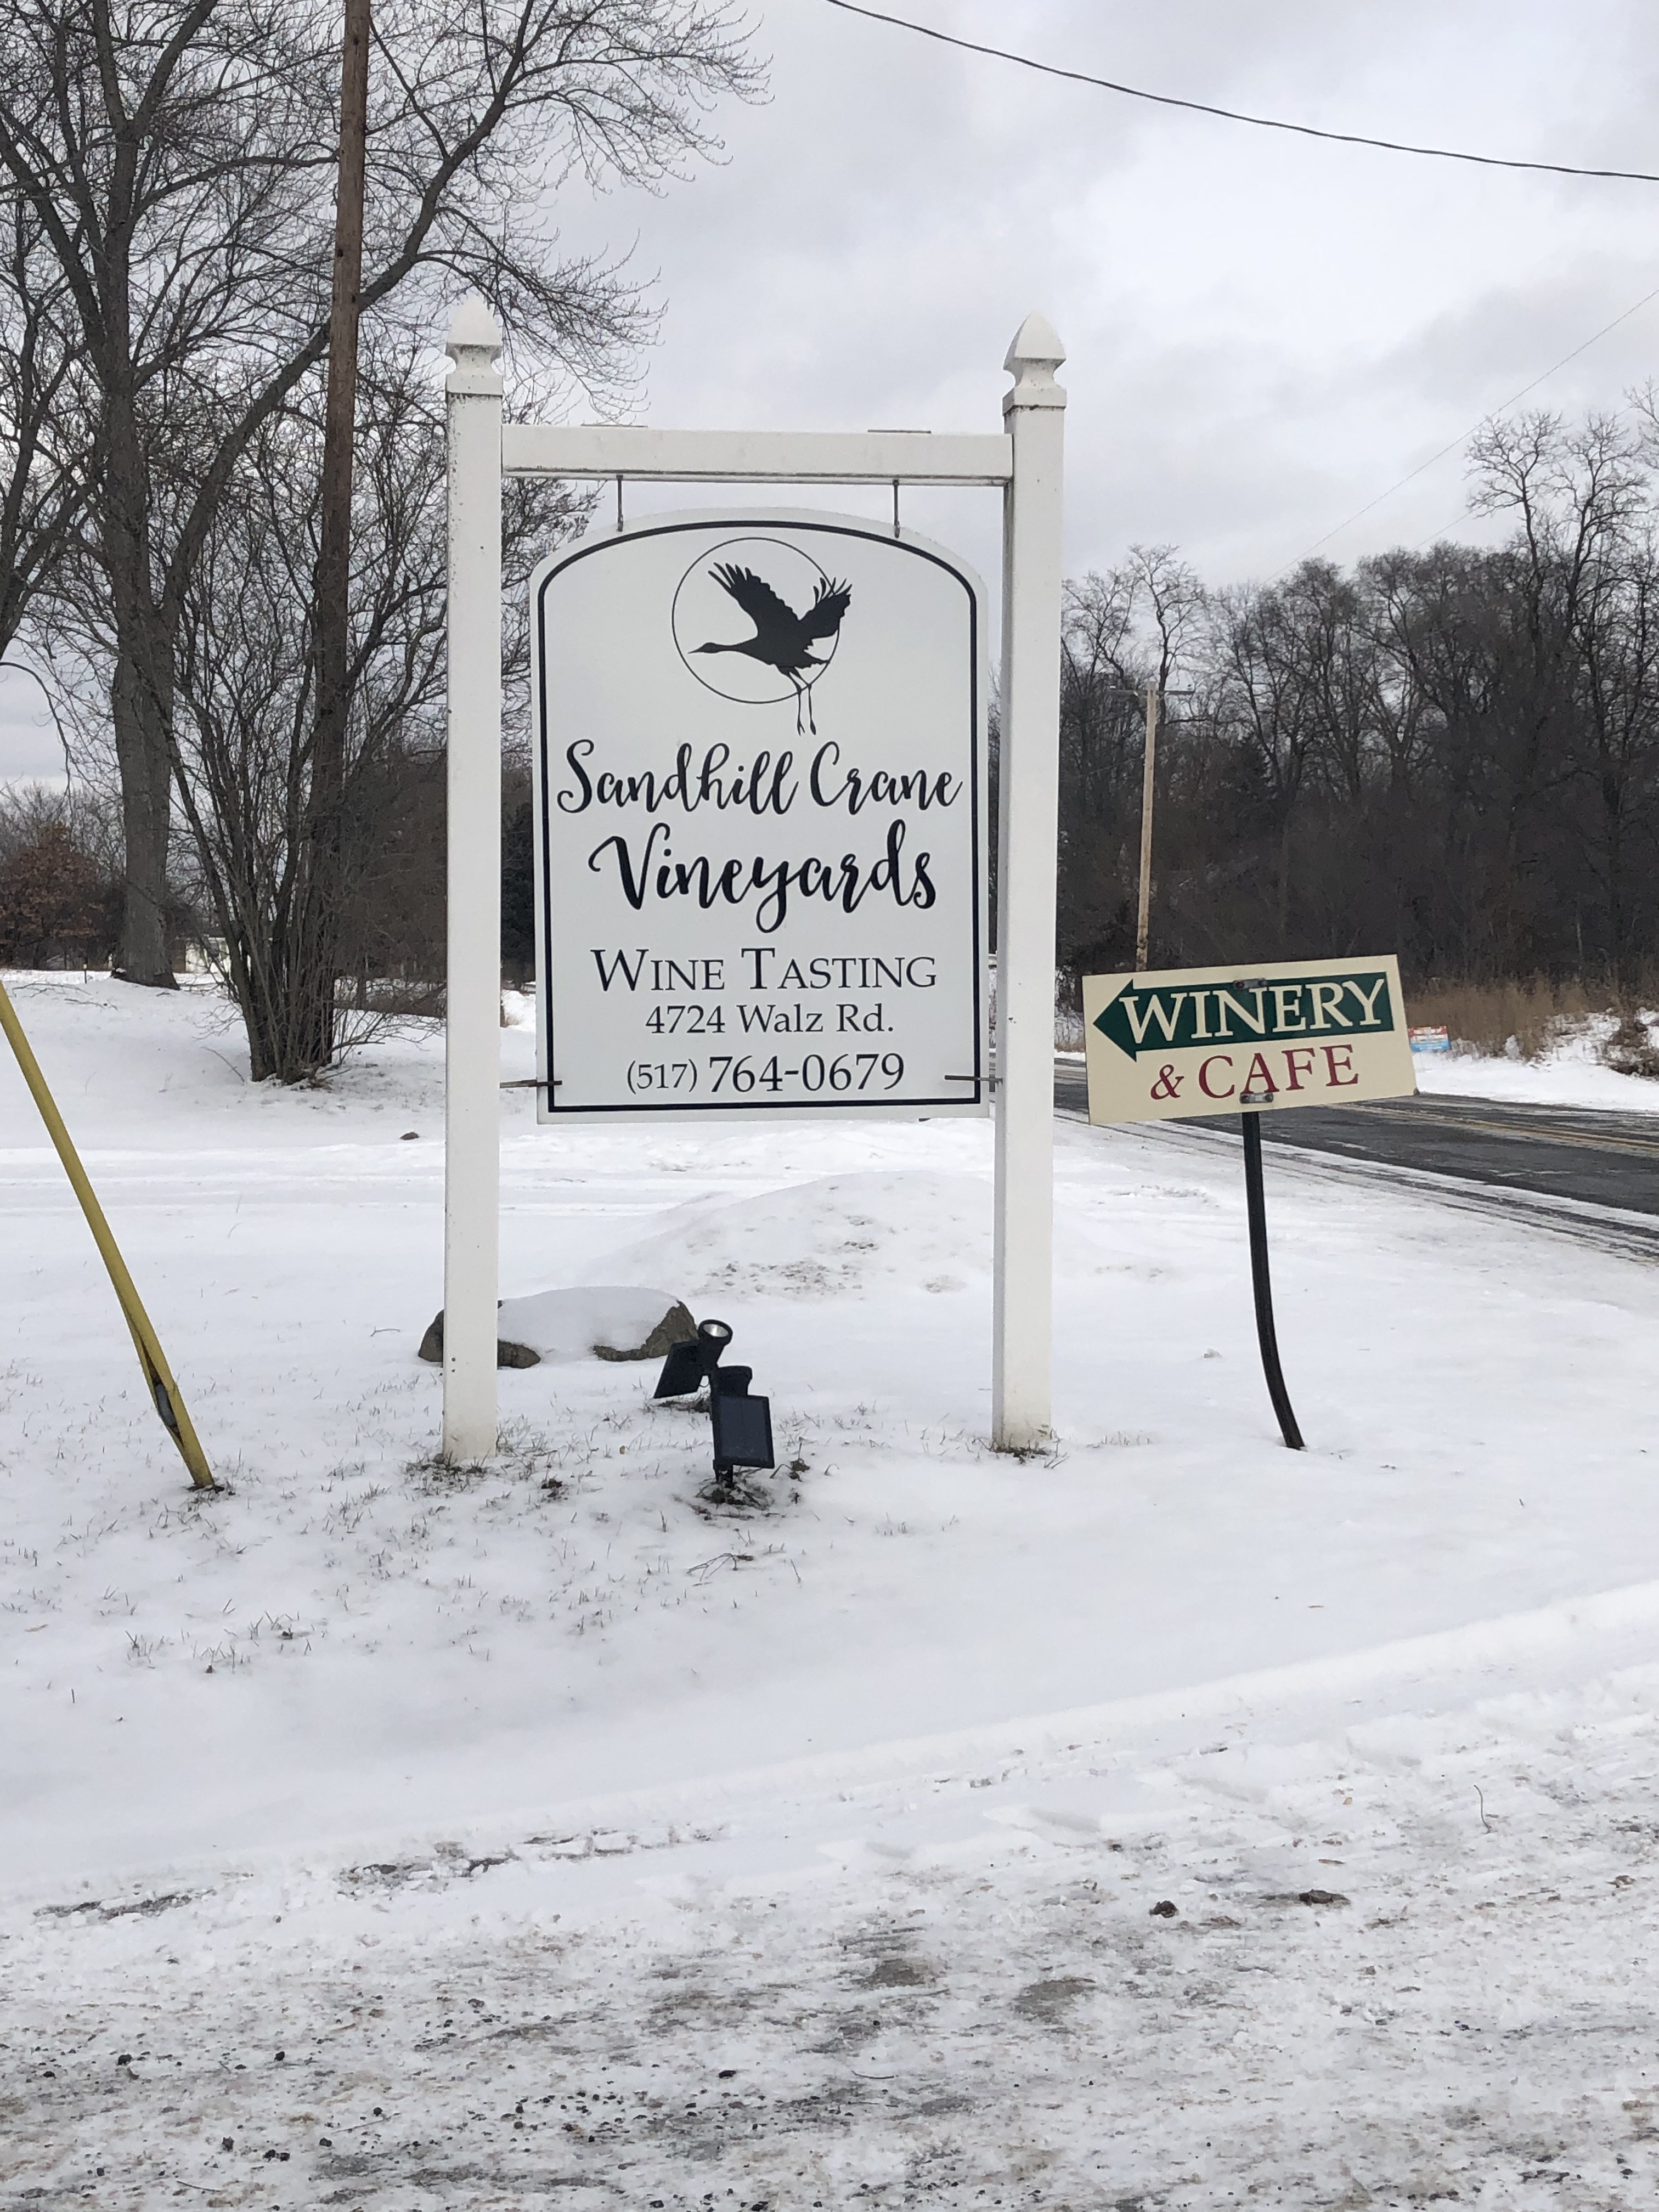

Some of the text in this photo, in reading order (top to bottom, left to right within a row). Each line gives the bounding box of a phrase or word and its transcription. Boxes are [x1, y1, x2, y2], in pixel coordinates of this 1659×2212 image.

[556, 739, 963, 815] Sandhill Crane
[588, 819, 936, 934] Vineyards
[590, 947, 936, 992] WINE TASTING
[645, 1003, 894, 1034] 4724 Walz Rd.
[1118, 978, 1385, 1045] WINERY
[627, 1053, 904, 1094] (517) 764-0679
[1150, 1043, 1359, 1101] & CAFE
